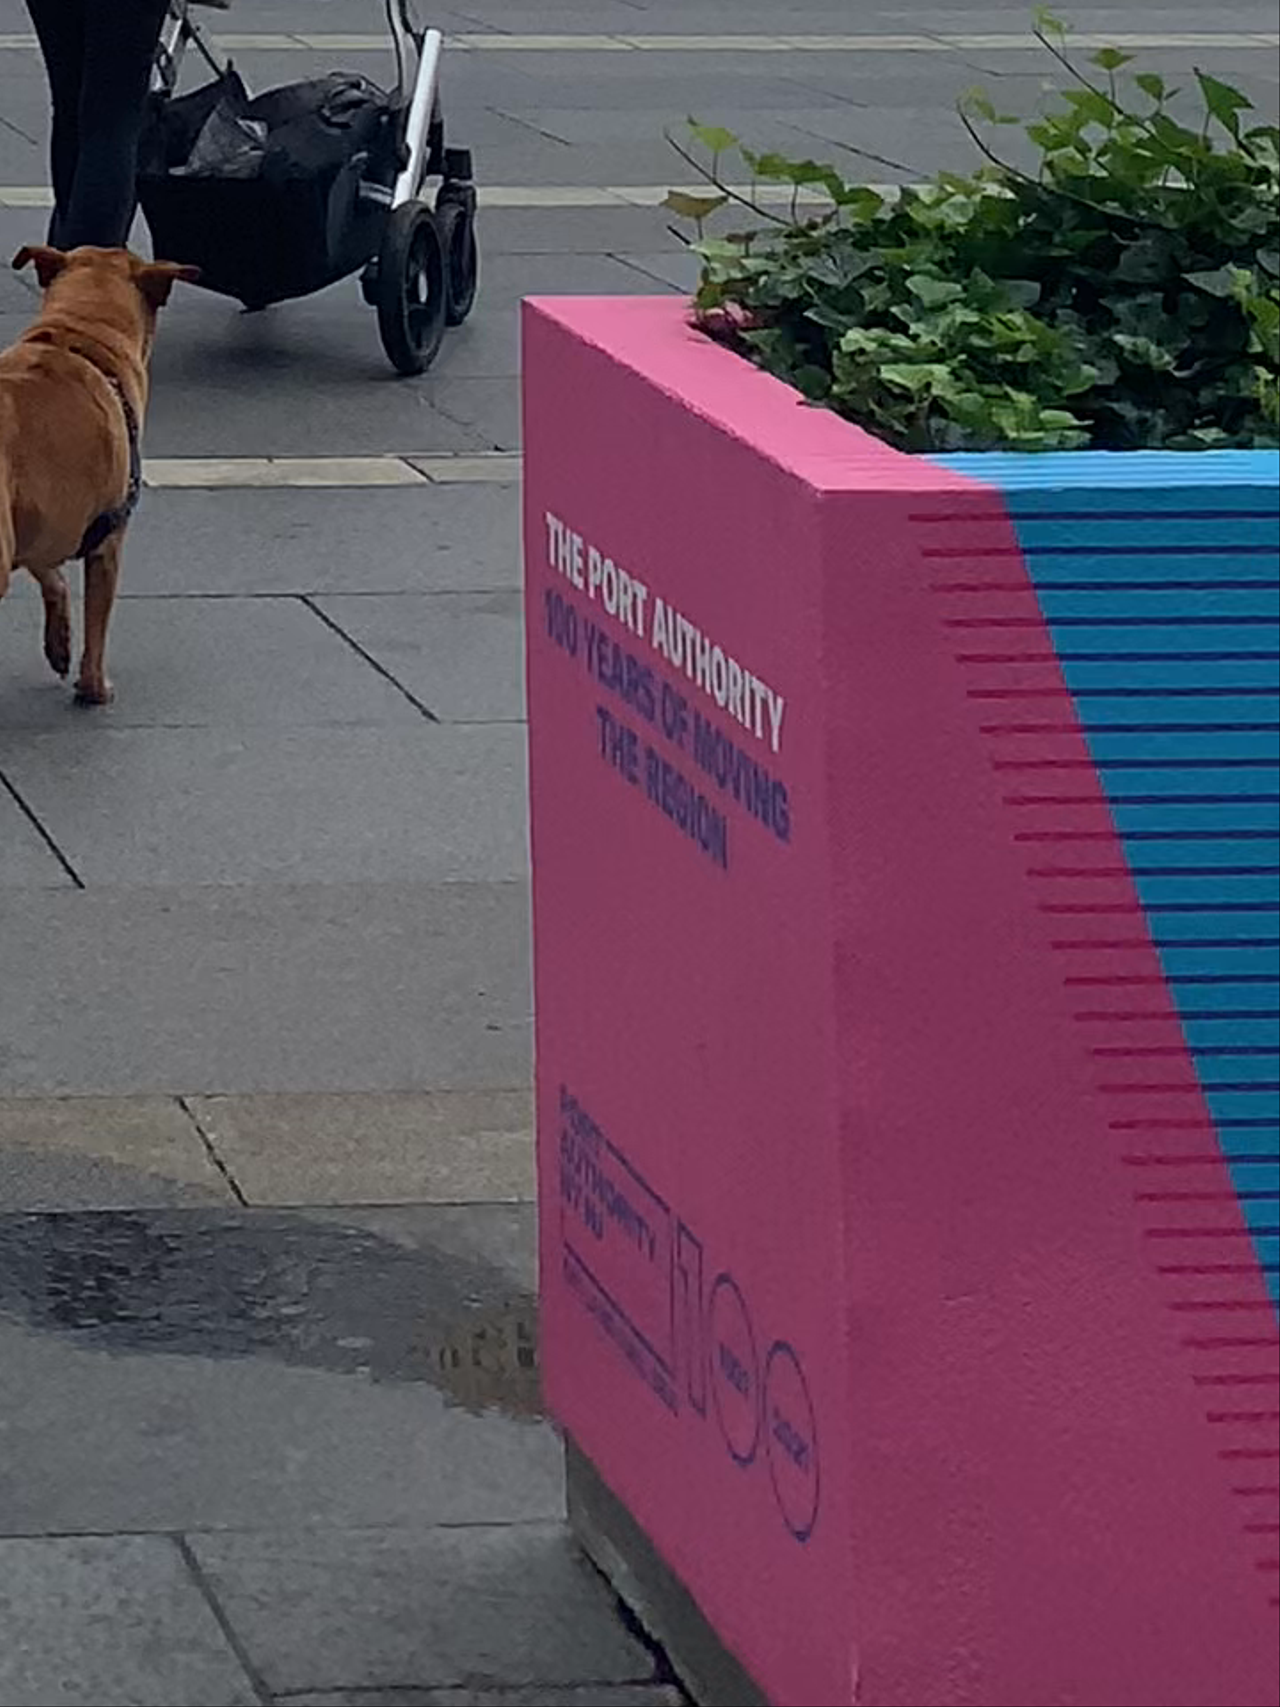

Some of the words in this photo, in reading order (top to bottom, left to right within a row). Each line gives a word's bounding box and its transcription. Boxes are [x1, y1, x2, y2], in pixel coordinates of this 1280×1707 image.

[545, 586, 579, 658] 100
[584, 616, 657, 724] YEARS
[660, 682, 689, 751] OF
[692, 708, 790, 845] MOVING
[546, 510, 584, 590] THE
[588, 545, 648, 638] PORT
[651, 597, 784, 754] AUTHORITY
[595, 704, 640, 786] THE
[643, 744, 728, 871] REGION
